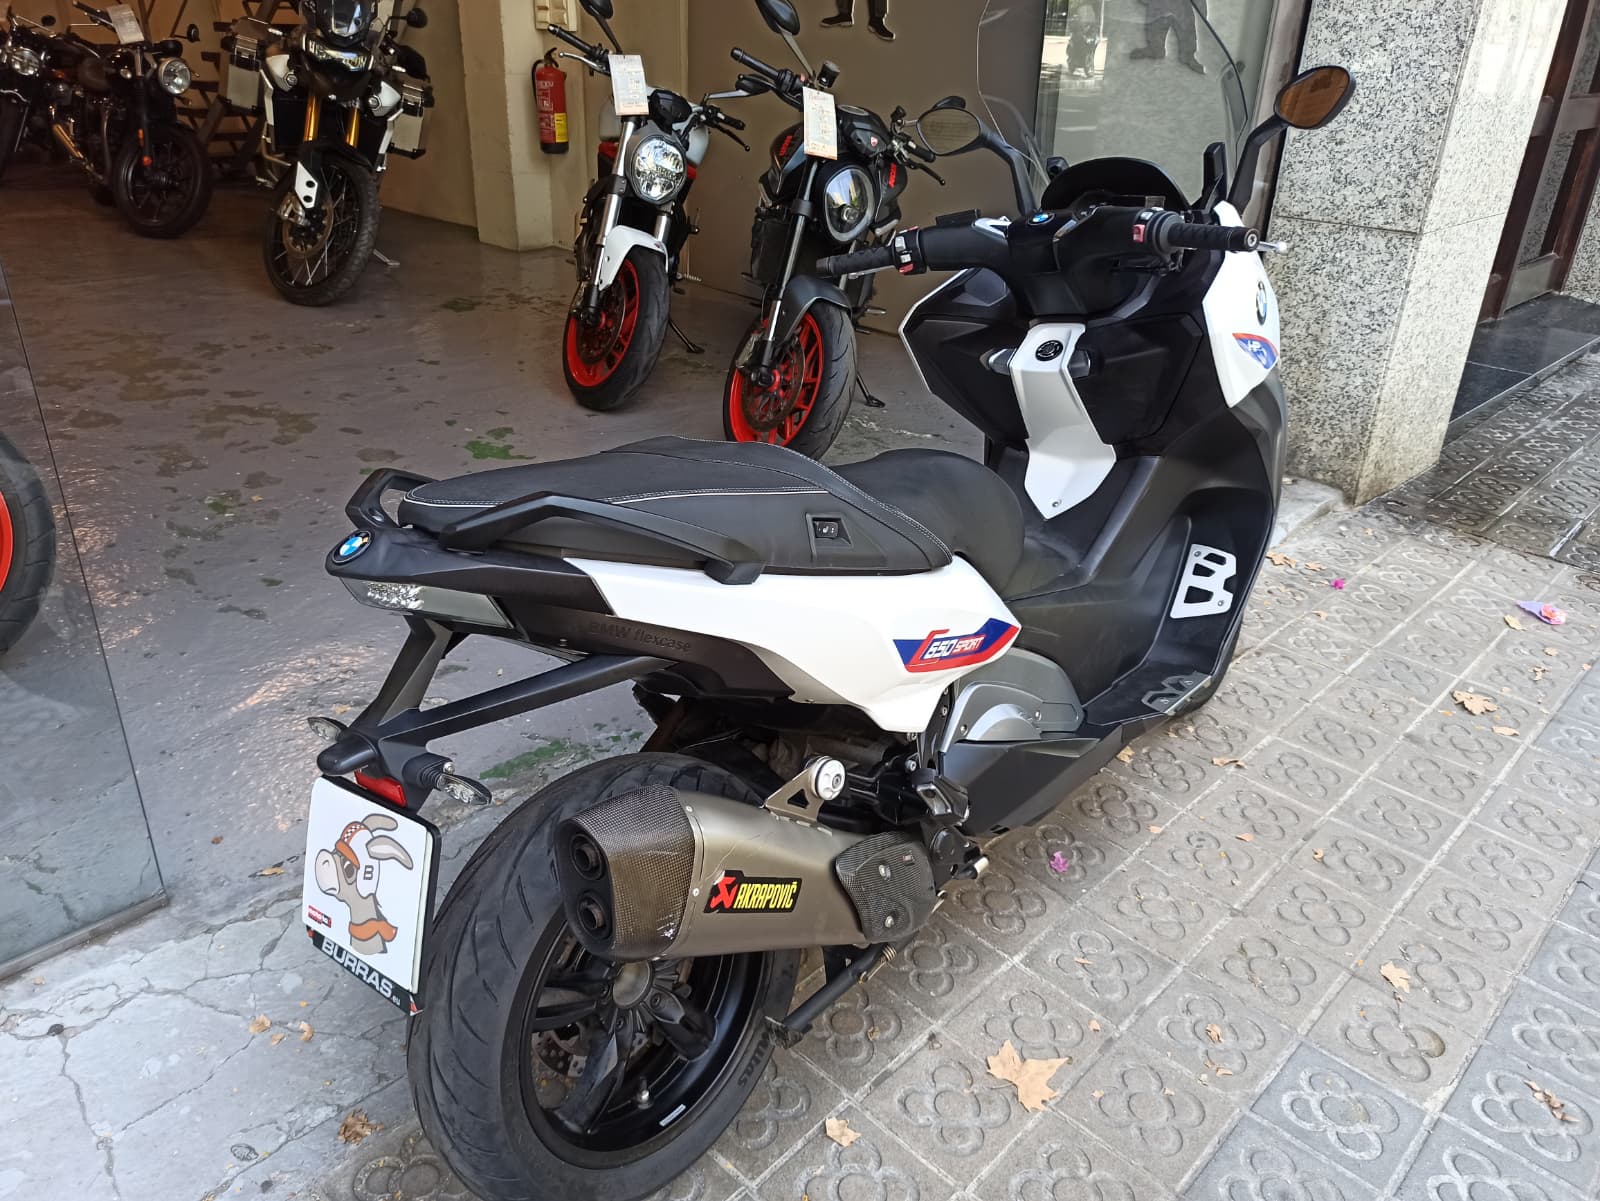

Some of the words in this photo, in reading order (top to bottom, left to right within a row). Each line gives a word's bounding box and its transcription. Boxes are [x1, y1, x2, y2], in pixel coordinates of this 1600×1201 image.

[632, 627, 692, 652] flexcase
[923, 639, 958, 660] 650
[951, 636, 985, 654] SPORT
